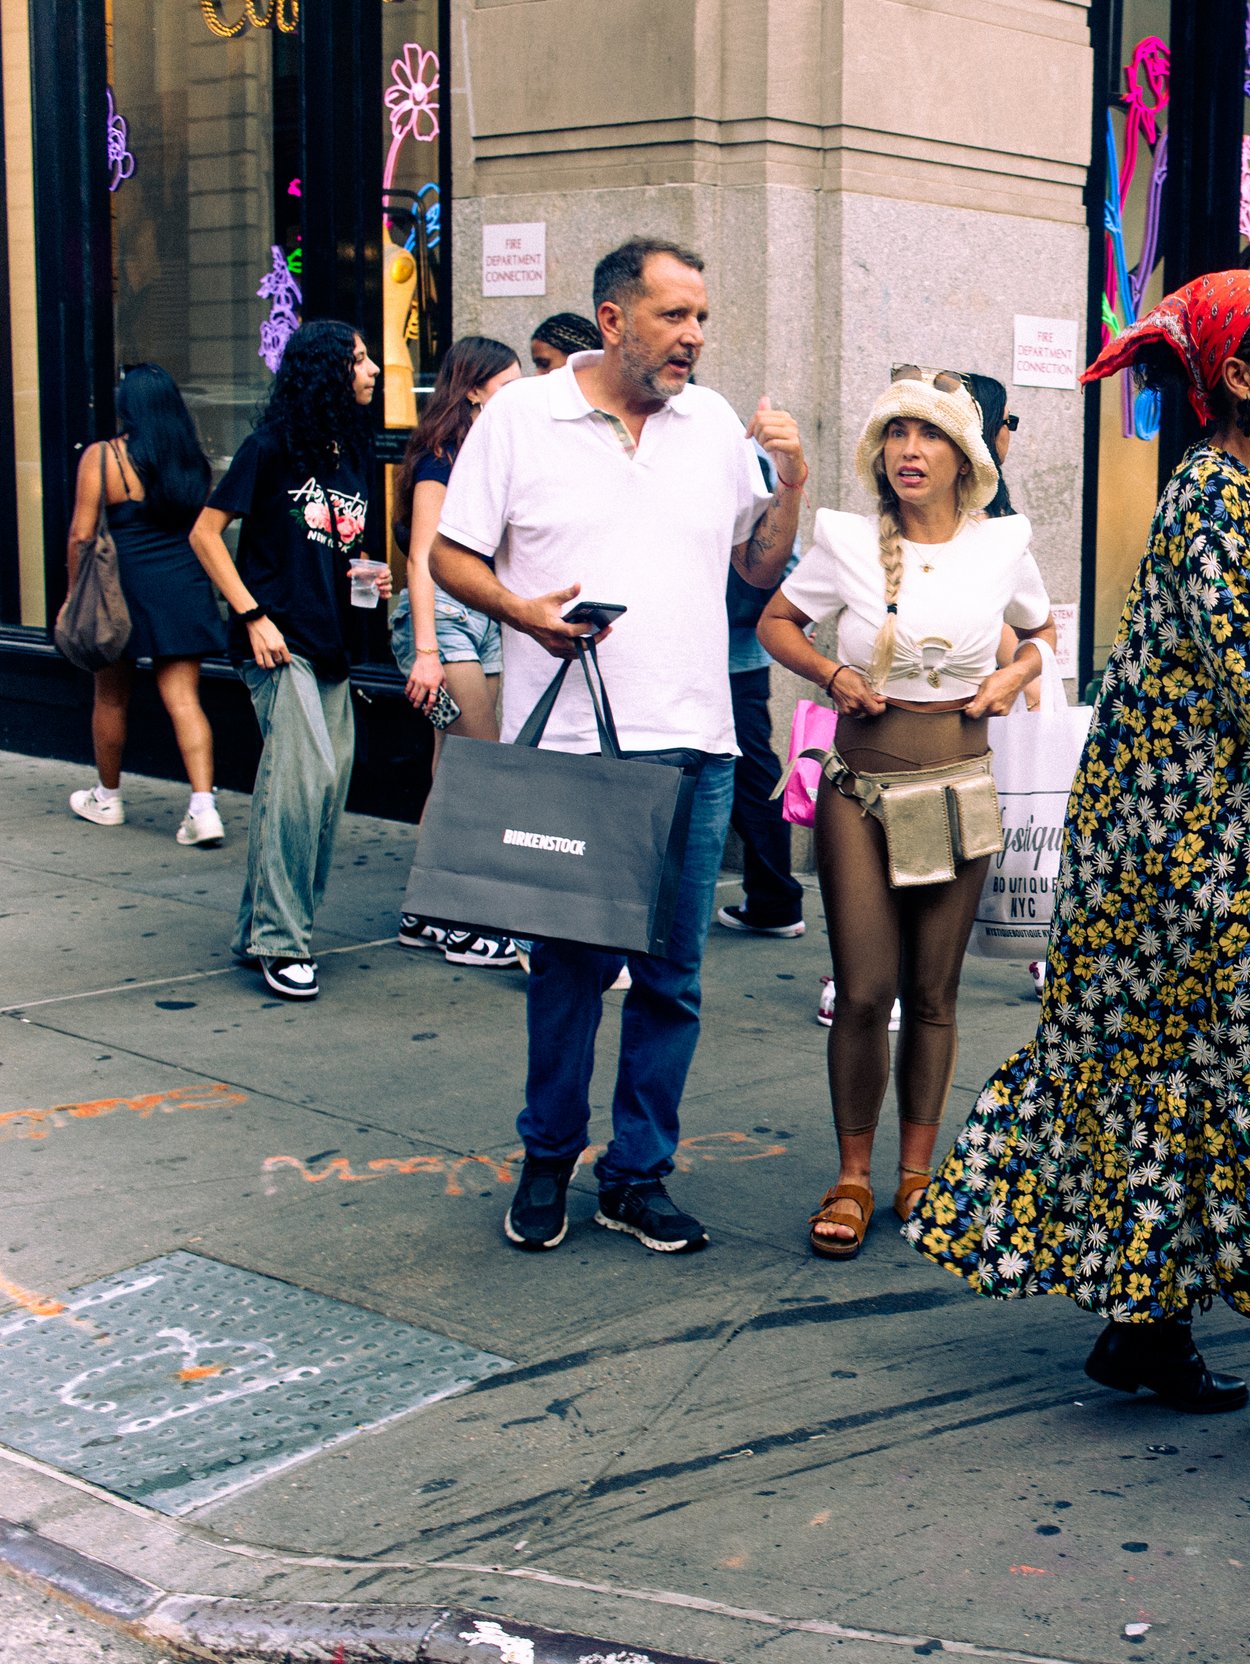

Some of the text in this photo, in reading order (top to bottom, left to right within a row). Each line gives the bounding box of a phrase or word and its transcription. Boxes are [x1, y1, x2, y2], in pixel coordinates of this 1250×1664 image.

[505, 238, 521, 249] FIRE
[486, 253, 541, 266] DEPARTMENT
[486, 270, 542, 282] CONNECTION
[1037, 330, 1053, 343] FIRE
[1017, 344, 1072, 358] DEPARTMENT
[1016, 360, 1073, 374] CONNECTION
[503, 829, 586, 855] BIRKENSTOCK
[993, 876, 1058, 893] BOUTIQUE
[1011, 897, 1036, 918] NYC
